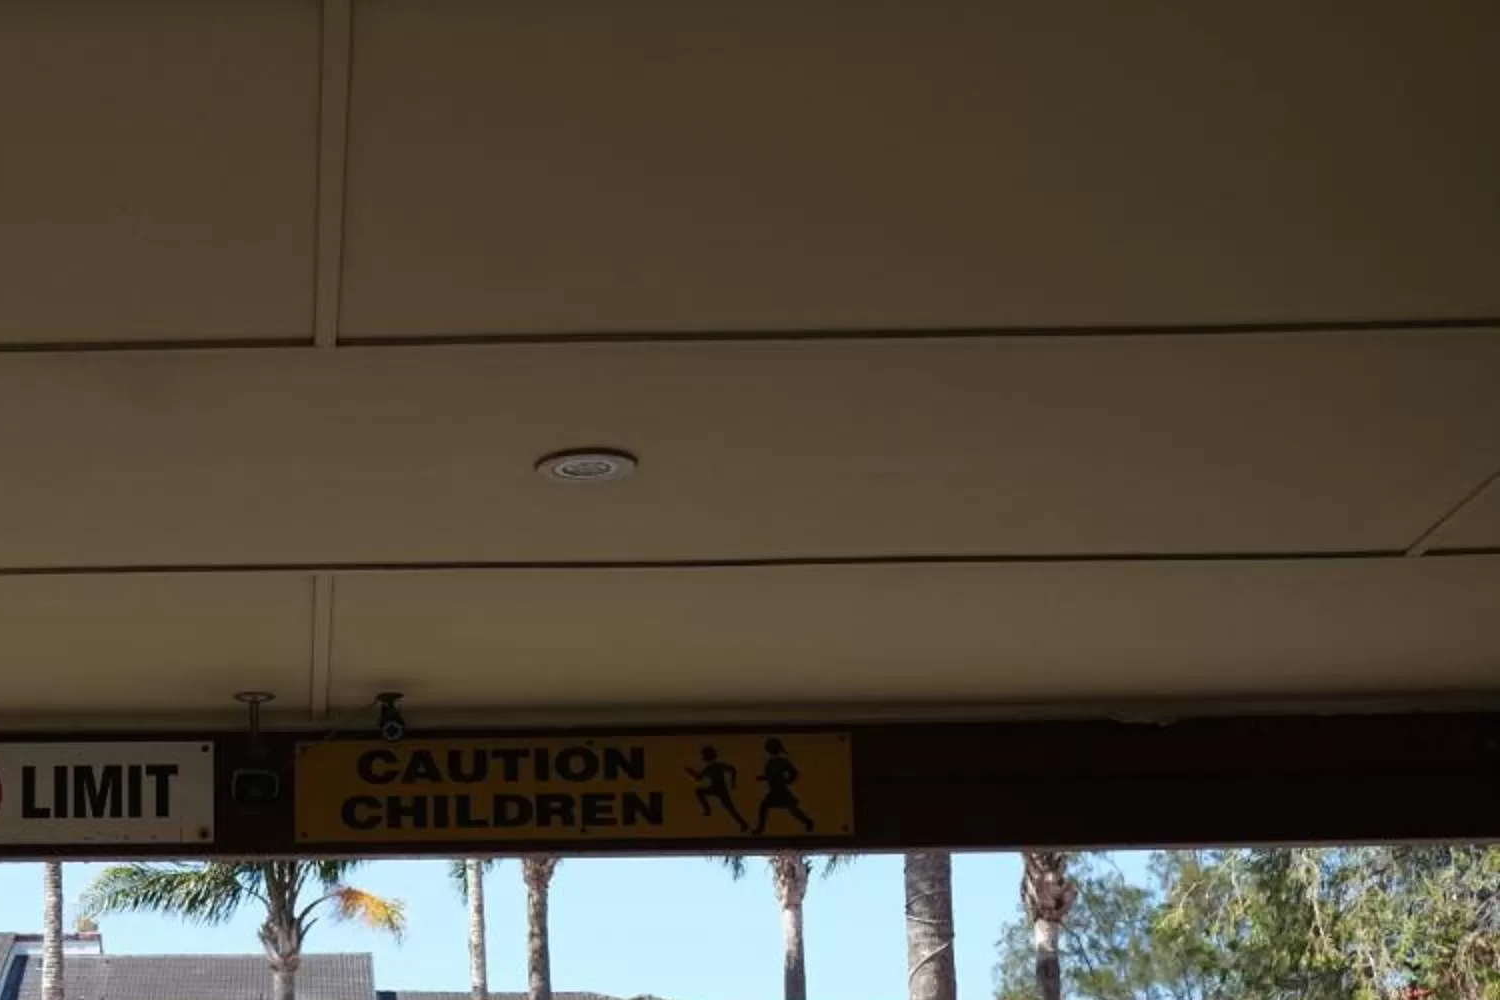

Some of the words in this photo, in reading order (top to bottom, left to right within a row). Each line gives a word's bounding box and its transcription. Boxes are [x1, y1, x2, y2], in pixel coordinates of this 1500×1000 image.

[356, 747, 646, 785] CAUTION
[21, 764, 180, 819] LIMIT
[341, 793, 666, 830] CHILDREN
